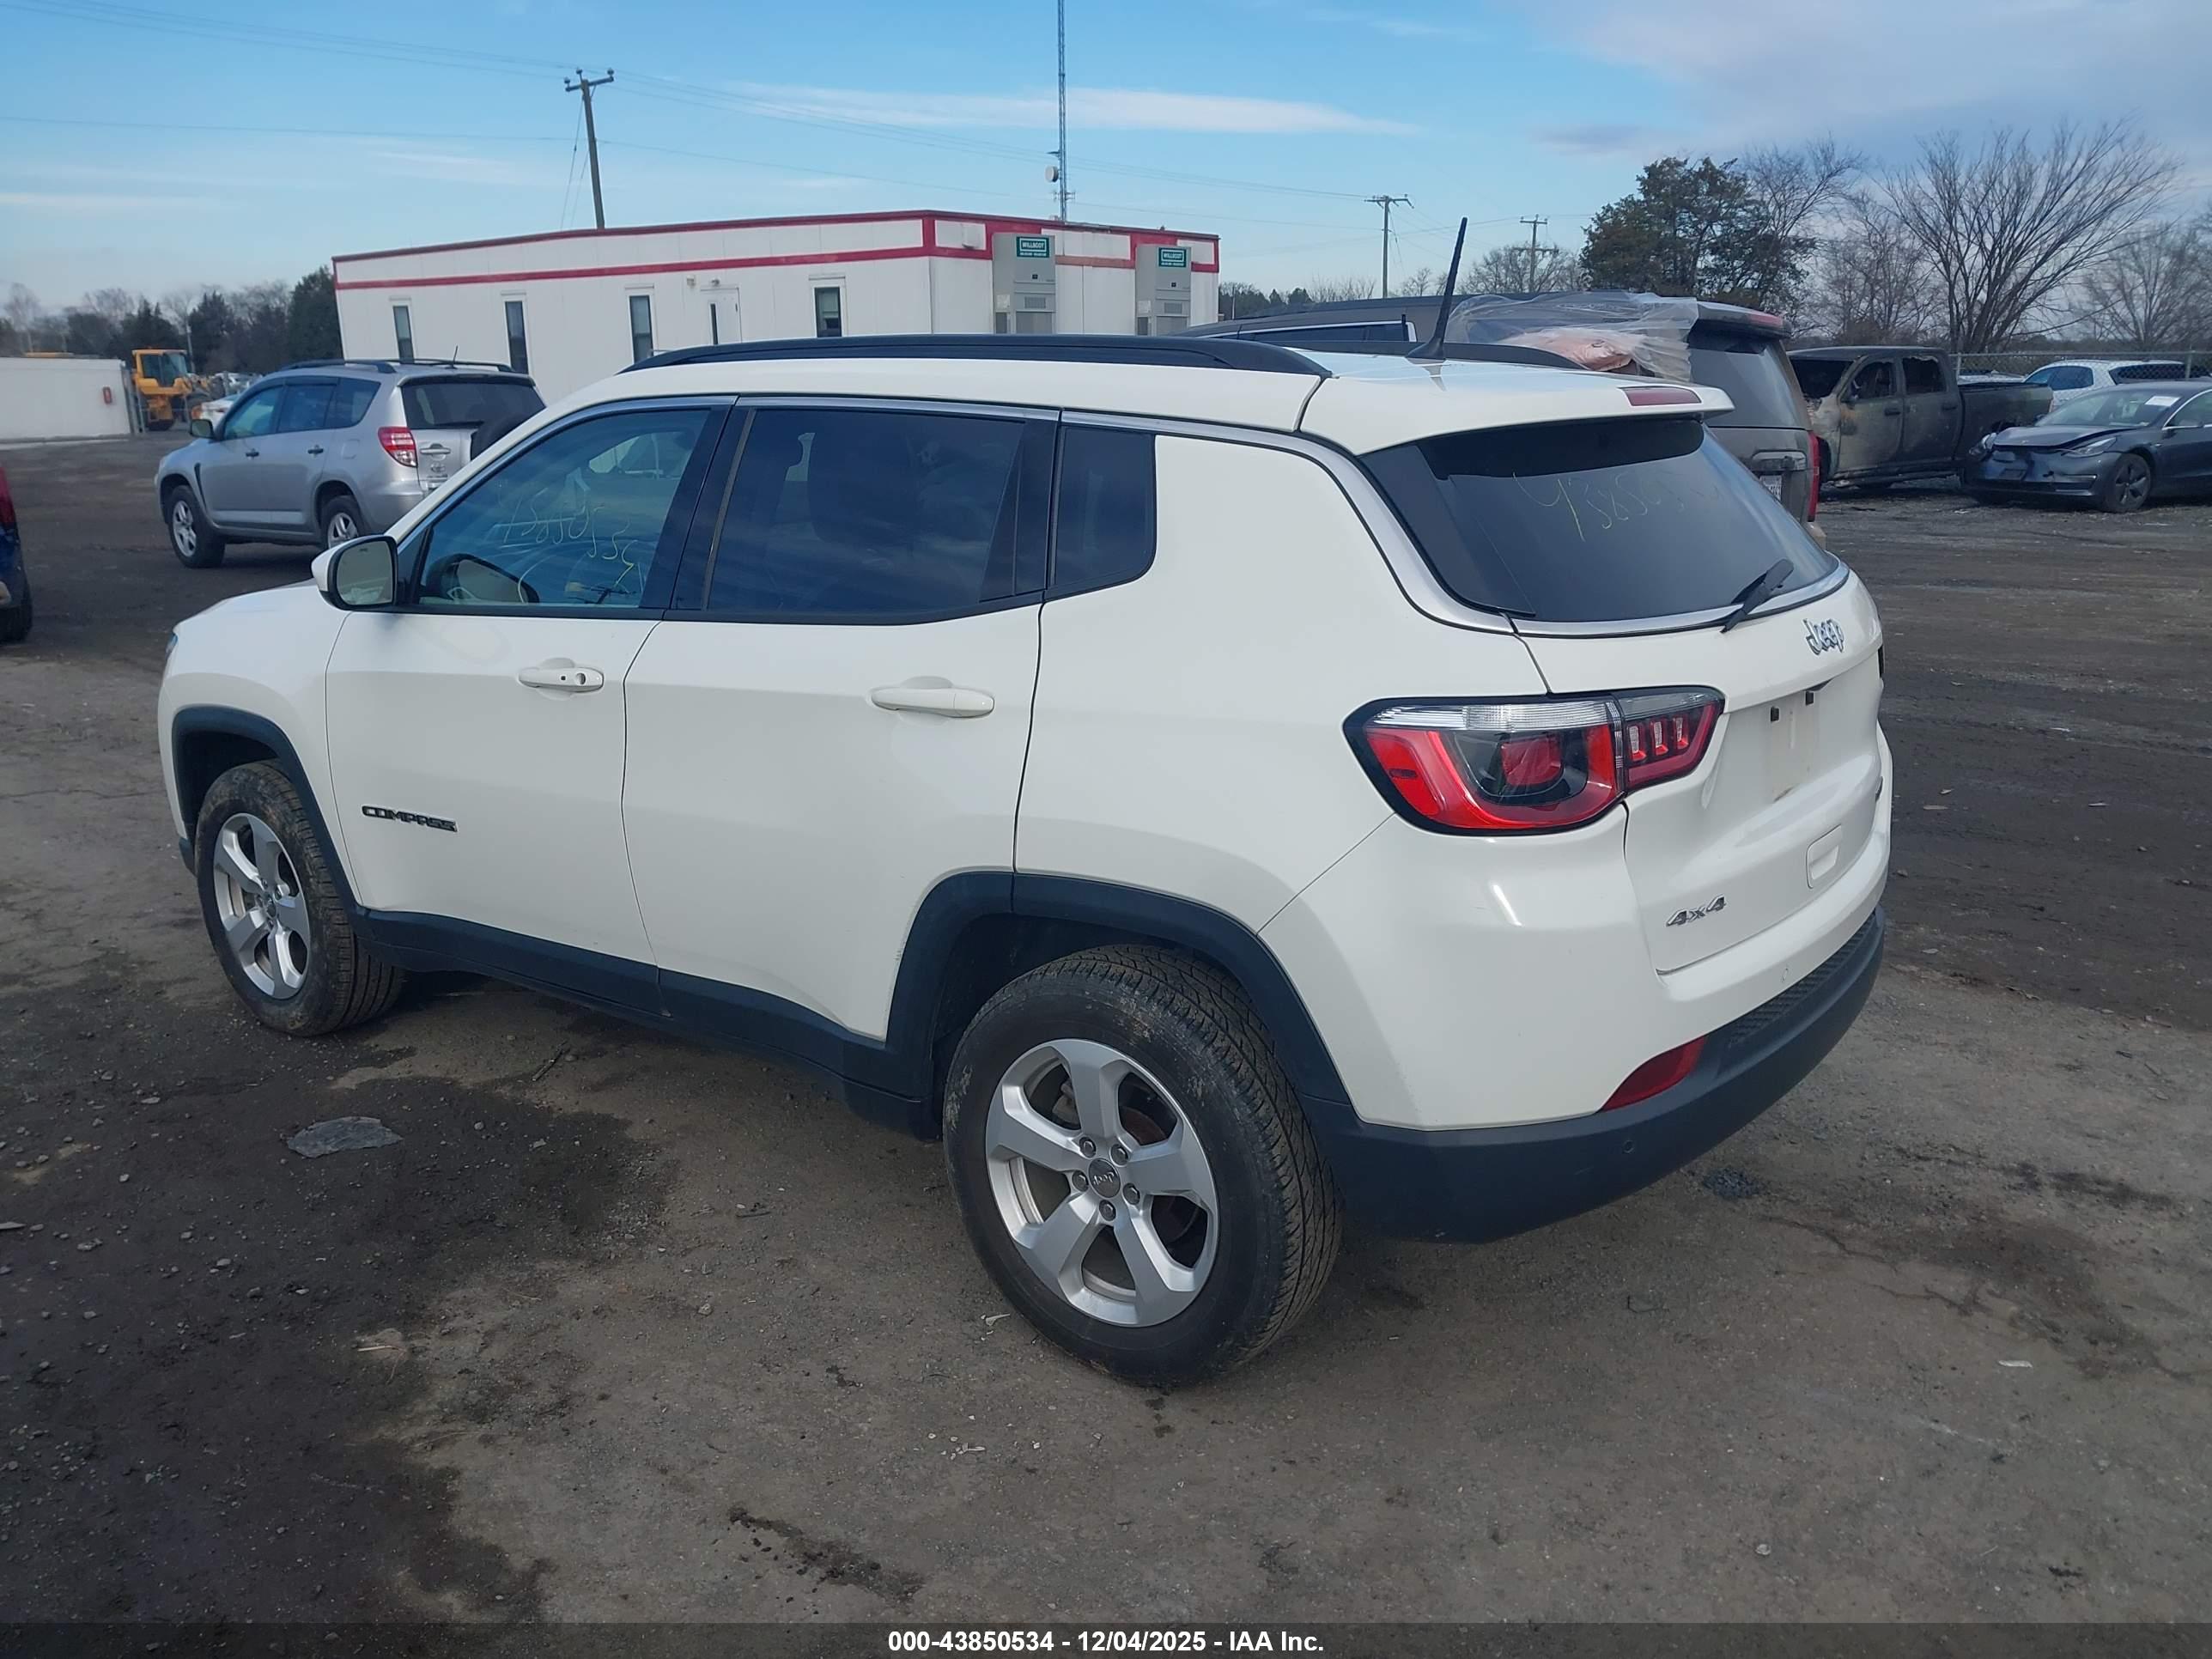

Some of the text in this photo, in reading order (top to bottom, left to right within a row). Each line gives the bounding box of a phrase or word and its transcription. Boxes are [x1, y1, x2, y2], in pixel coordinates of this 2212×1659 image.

[1802, 618, 1844, 655] Jeep
[362, 805, 458, 832] COMPASS
[1666, 894, 1727, 927] 4x4
